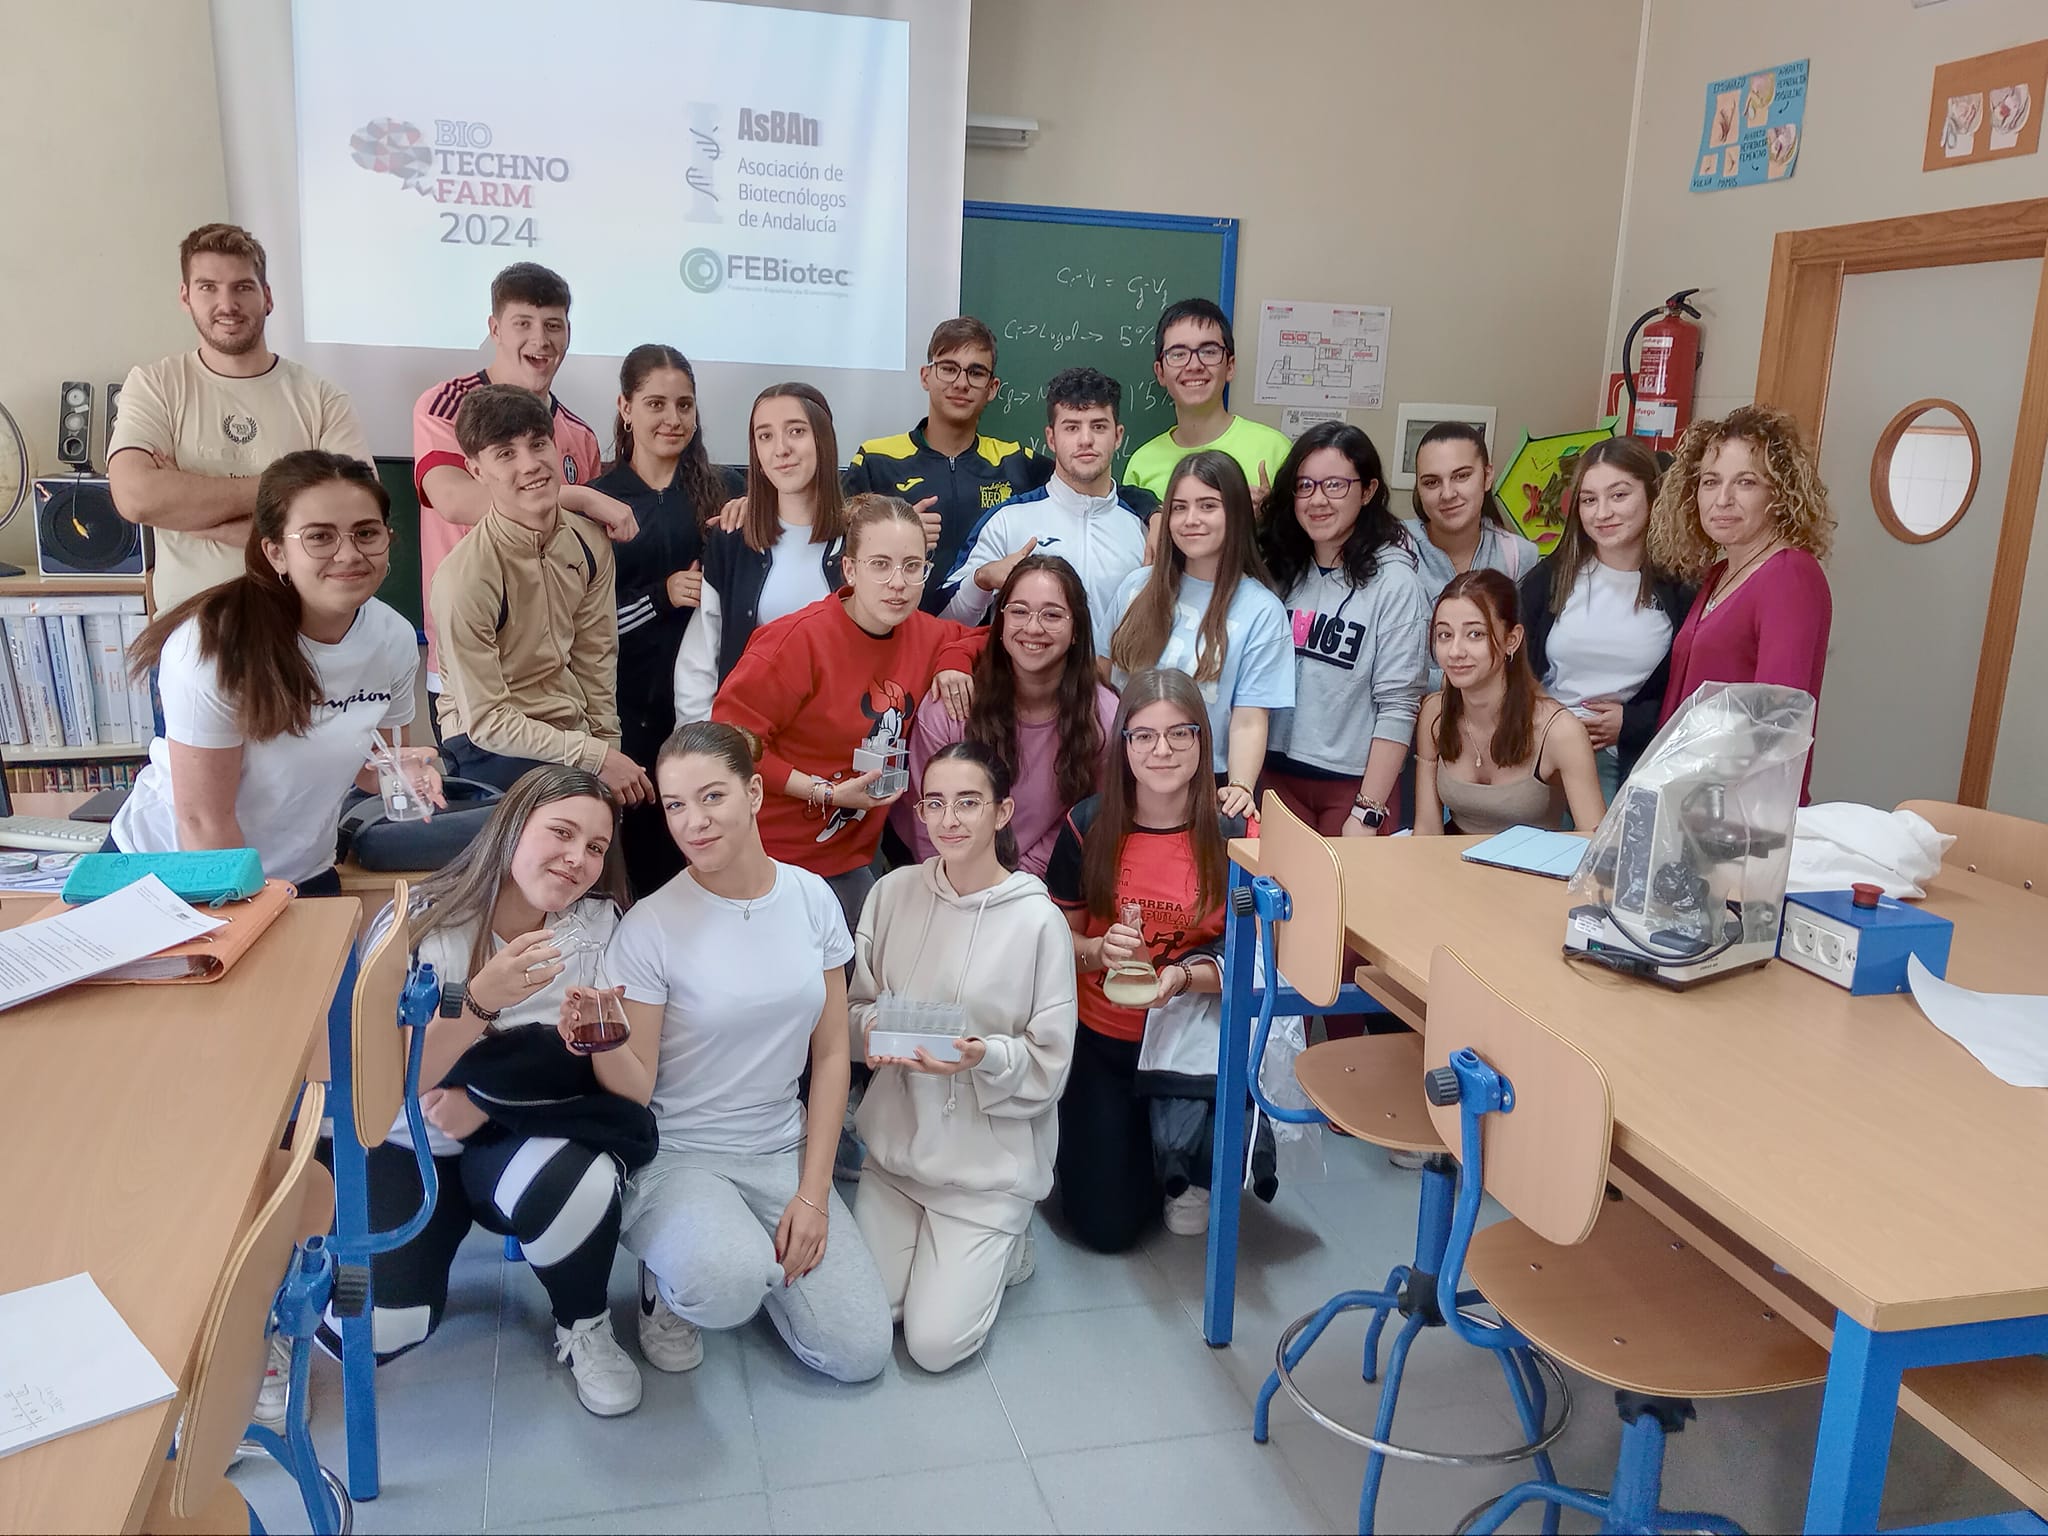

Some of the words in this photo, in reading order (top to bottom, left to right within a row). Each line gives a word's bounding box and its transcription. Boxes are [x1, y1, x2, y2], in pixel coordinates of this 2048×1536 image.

[434, 119, 493, 149] BIO
[737, 107, 820, 147] AsBAn
[434, 148, 570, 183] TECHNO
[737, 157, 819, 181] Asociación
[824, 163, 844, 182] de
[436, 178, 533, 209] FARM
[738, 182, 847, 212] Biotecnólogos
[439, 211, 538, 248] 2024
[738, 209, 758, 228] de
[761, 211, 837, 233] Andalucía
[727, 254, 850, 287] FEBiotec
[323, 688, 392, 713] mpion
[1121, 896, 1183, 912] CARRERA
